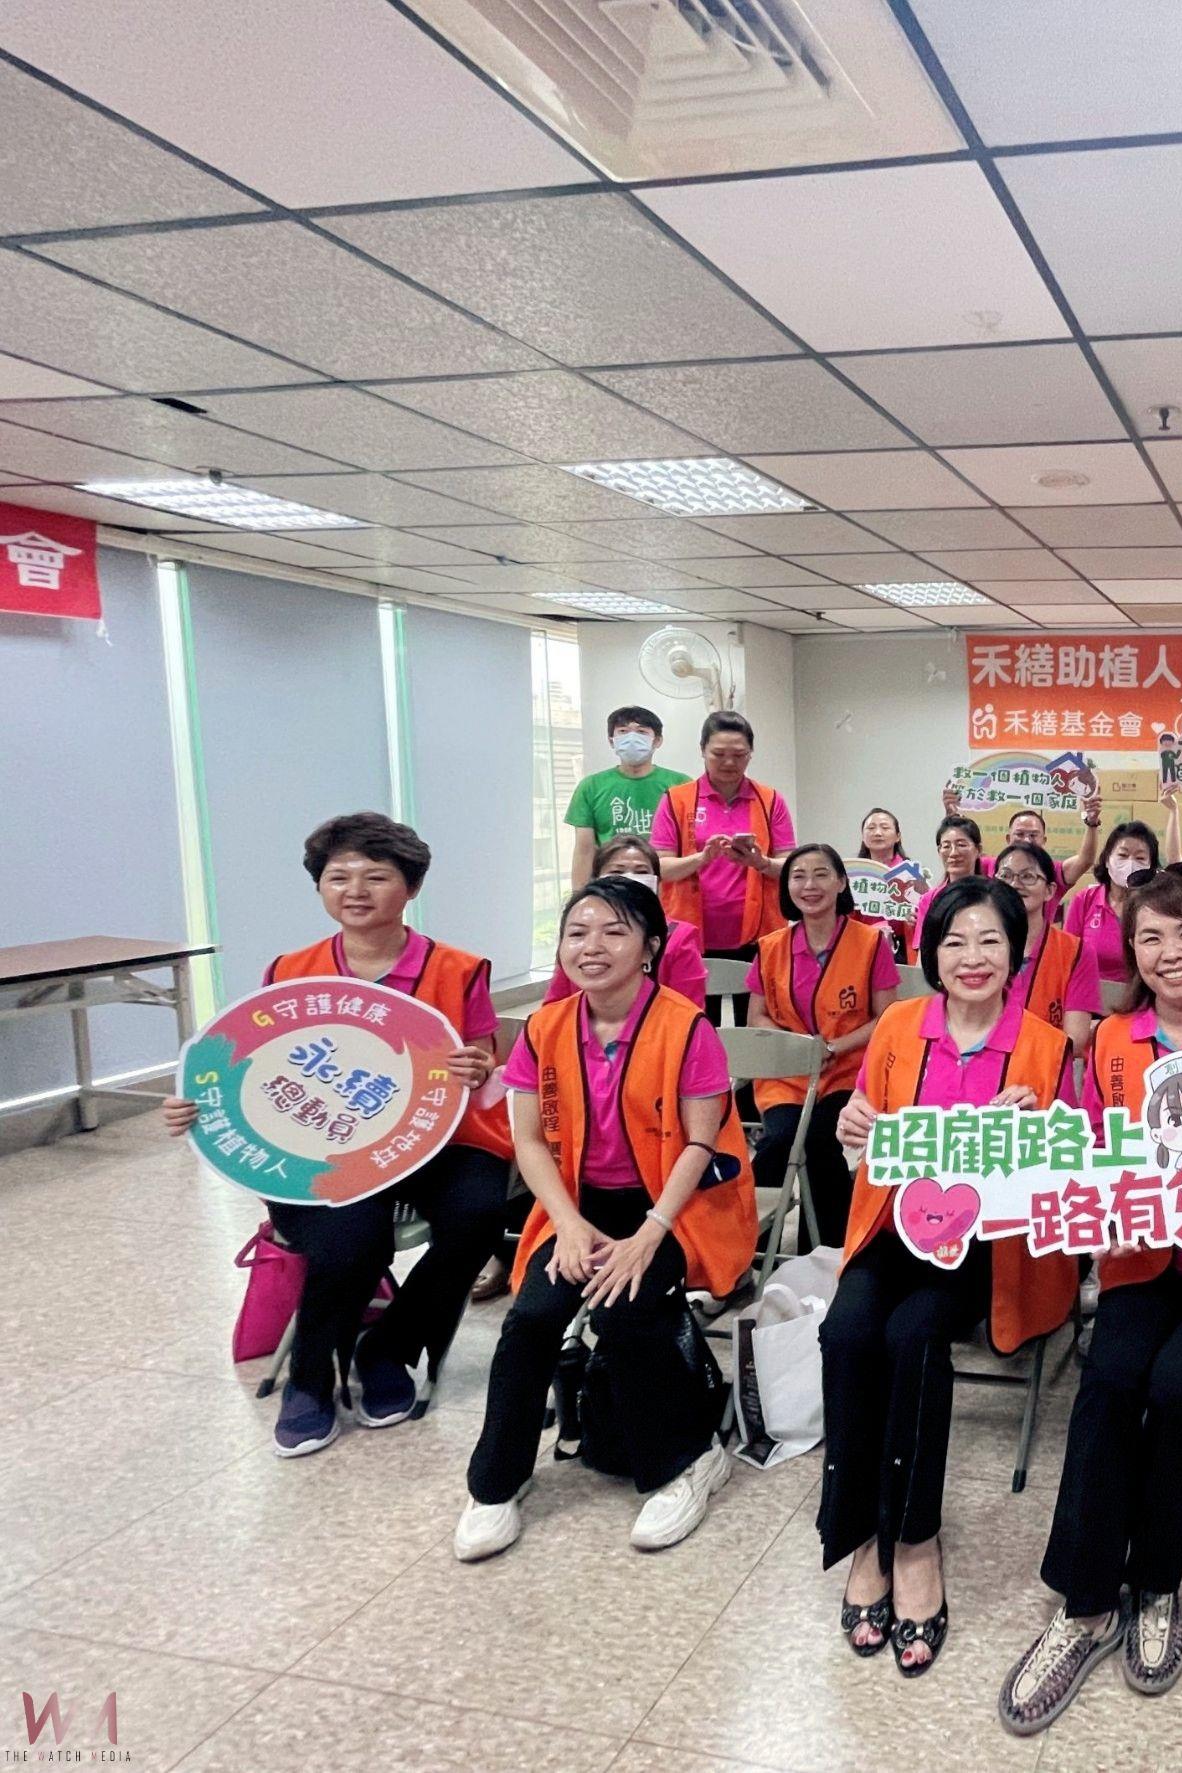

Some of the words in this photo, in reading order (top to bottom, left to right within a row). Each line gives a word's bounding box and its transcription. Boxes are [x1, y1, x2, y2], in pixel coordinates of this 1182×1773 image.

[0, 531, 82, 590] 會
[971, 643, 1182, 689] 禾繕助植人
[1003, 709, 1143, 738] 禾繕基金會
[953, 766, 1064, 786] 救一個植物人
[853, 878, 901, 894] 植物人
[252, 1010, 275, 1027] G
[273, 993, 392, 1026] 守護健康
[289, 1037, 398, 1116] 永續
[195, 1086, 288, 1179] 守護植物人
[263, 1075, 358, 1142] 總動員
[370, 1087, 448, 1169] 守護地球
[873, 1106, 1147, 1179] 照顧路上
